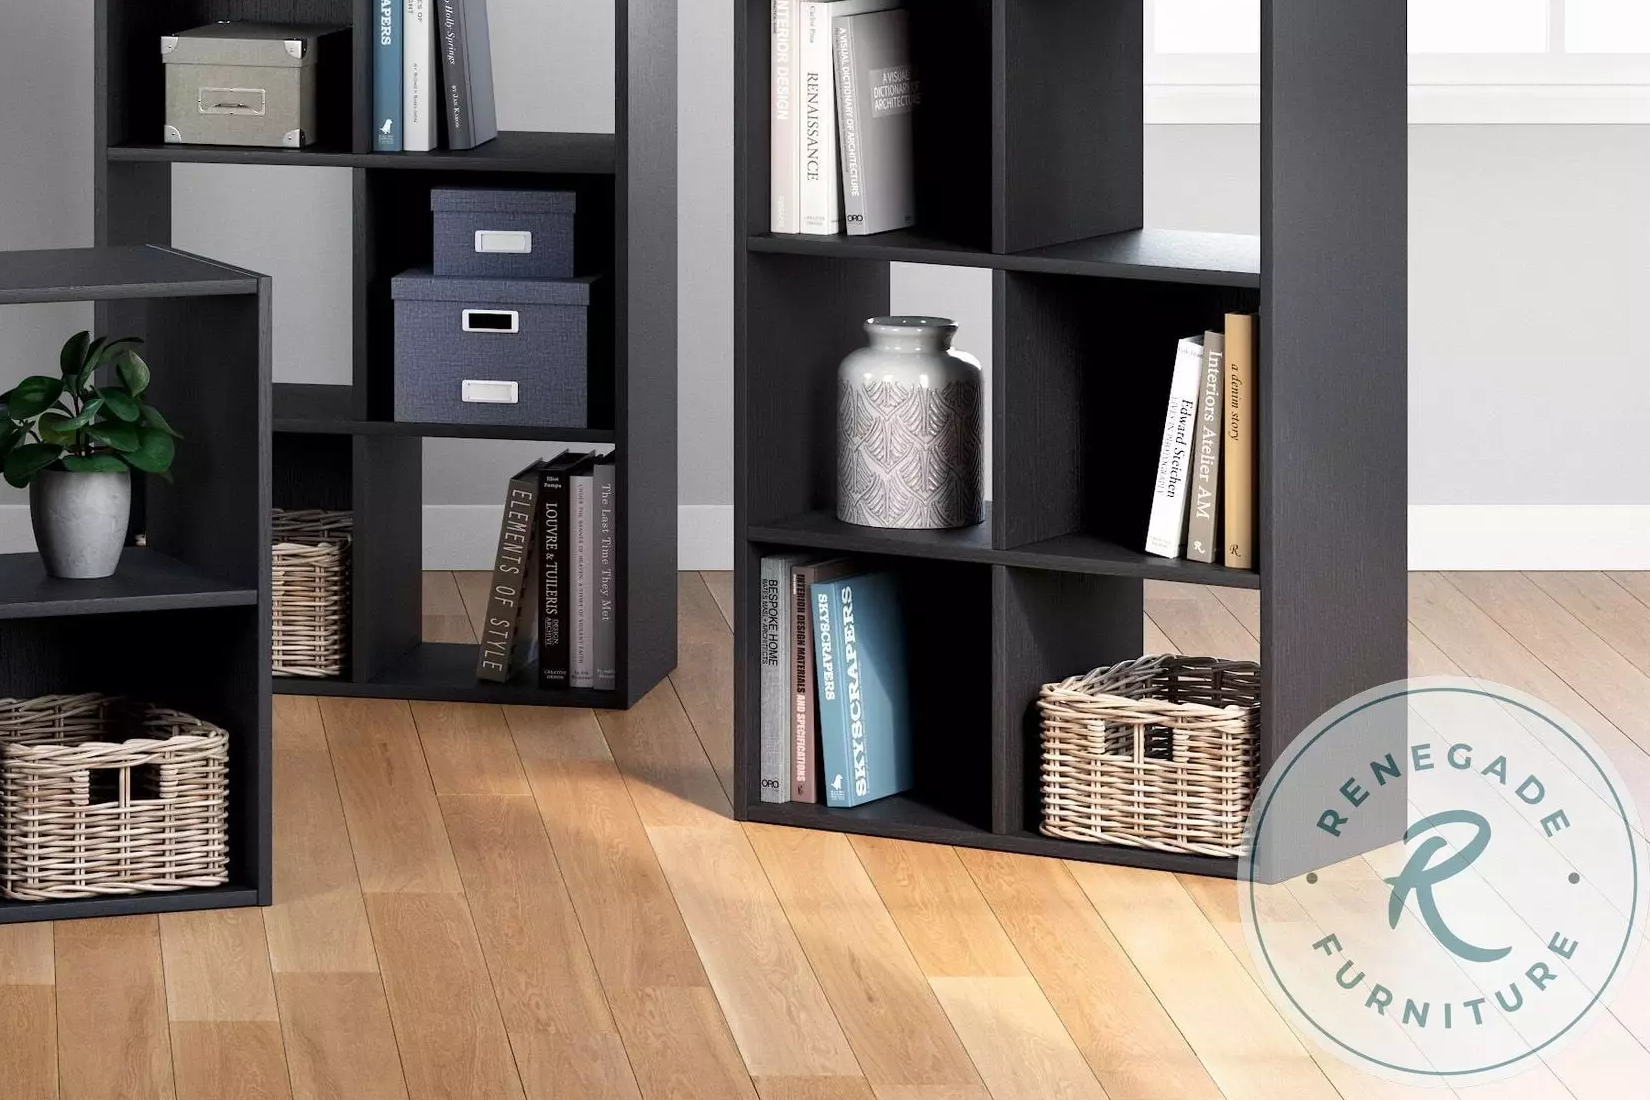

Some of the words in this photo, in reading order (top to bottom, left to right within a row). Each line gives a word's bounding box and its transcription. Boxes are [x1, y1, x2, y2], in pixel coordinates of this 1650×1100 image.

[444, 5, 454, 28] Holly
[446, 31, 455, 65] Springs
[840, 35, 849, 65] VISUAL
[777, 67, 789, 120] DESIGN
[842, 66, 853, 118] DICTIONARY
[883, 72, 888, 85] A
[888, 70, 910, 83] VISUAL
[807, 72, 819, 181] RENAISSANCE
[847, 119, 854, 130] OF
[847, 131, 859, 197] ARCHITECTURE
[1232, 363, 1239, 371] a
[1204, 350, 1223, 423] Interiors
[1230, 373, 1242, 409] denim
[1175, 400, 1193, 445] Edward
[1228, 411, 1240, 441] story
[1200, 427, 1217, 482] Atelier
[1167, 448, 1185, 498] Steichen
[601, 484, 612, 505] The
[1196, 485, 1212, 520] AM
[500, 489, 532, 575] ELEMENTS
[546, 503, 558, 550] LOUVRE
[601, 508, 612, 535] Last
[601, 538, 612, 565] Time
[1230, 544, 1242, 557] R
[496, 585, 516, 608] OF
[546, 561, 558, 615] TUILERIS
[599, 568, 612, 596] They
[797, 574, 805, 614] INTERIOR
[601, 600, 612, 621] Met
[769, 580, 778, 631] BESPOKE
[482, 618, 510, 672] STYLE
[797, 615, 805, 646] DESIGN
[818, 593, 835, 701] SKYSCRAPERS
[769, 633, 778, 666] HOME
[797, 647, 805, 693] MATERIALS
[796, 694, 805, 712] AND
[841, 586, 866, 796] SKYSCRAPERS
[796, 713, 805, 782] SPECIFICATIONS
[762, 779, 779, 788] ORO
